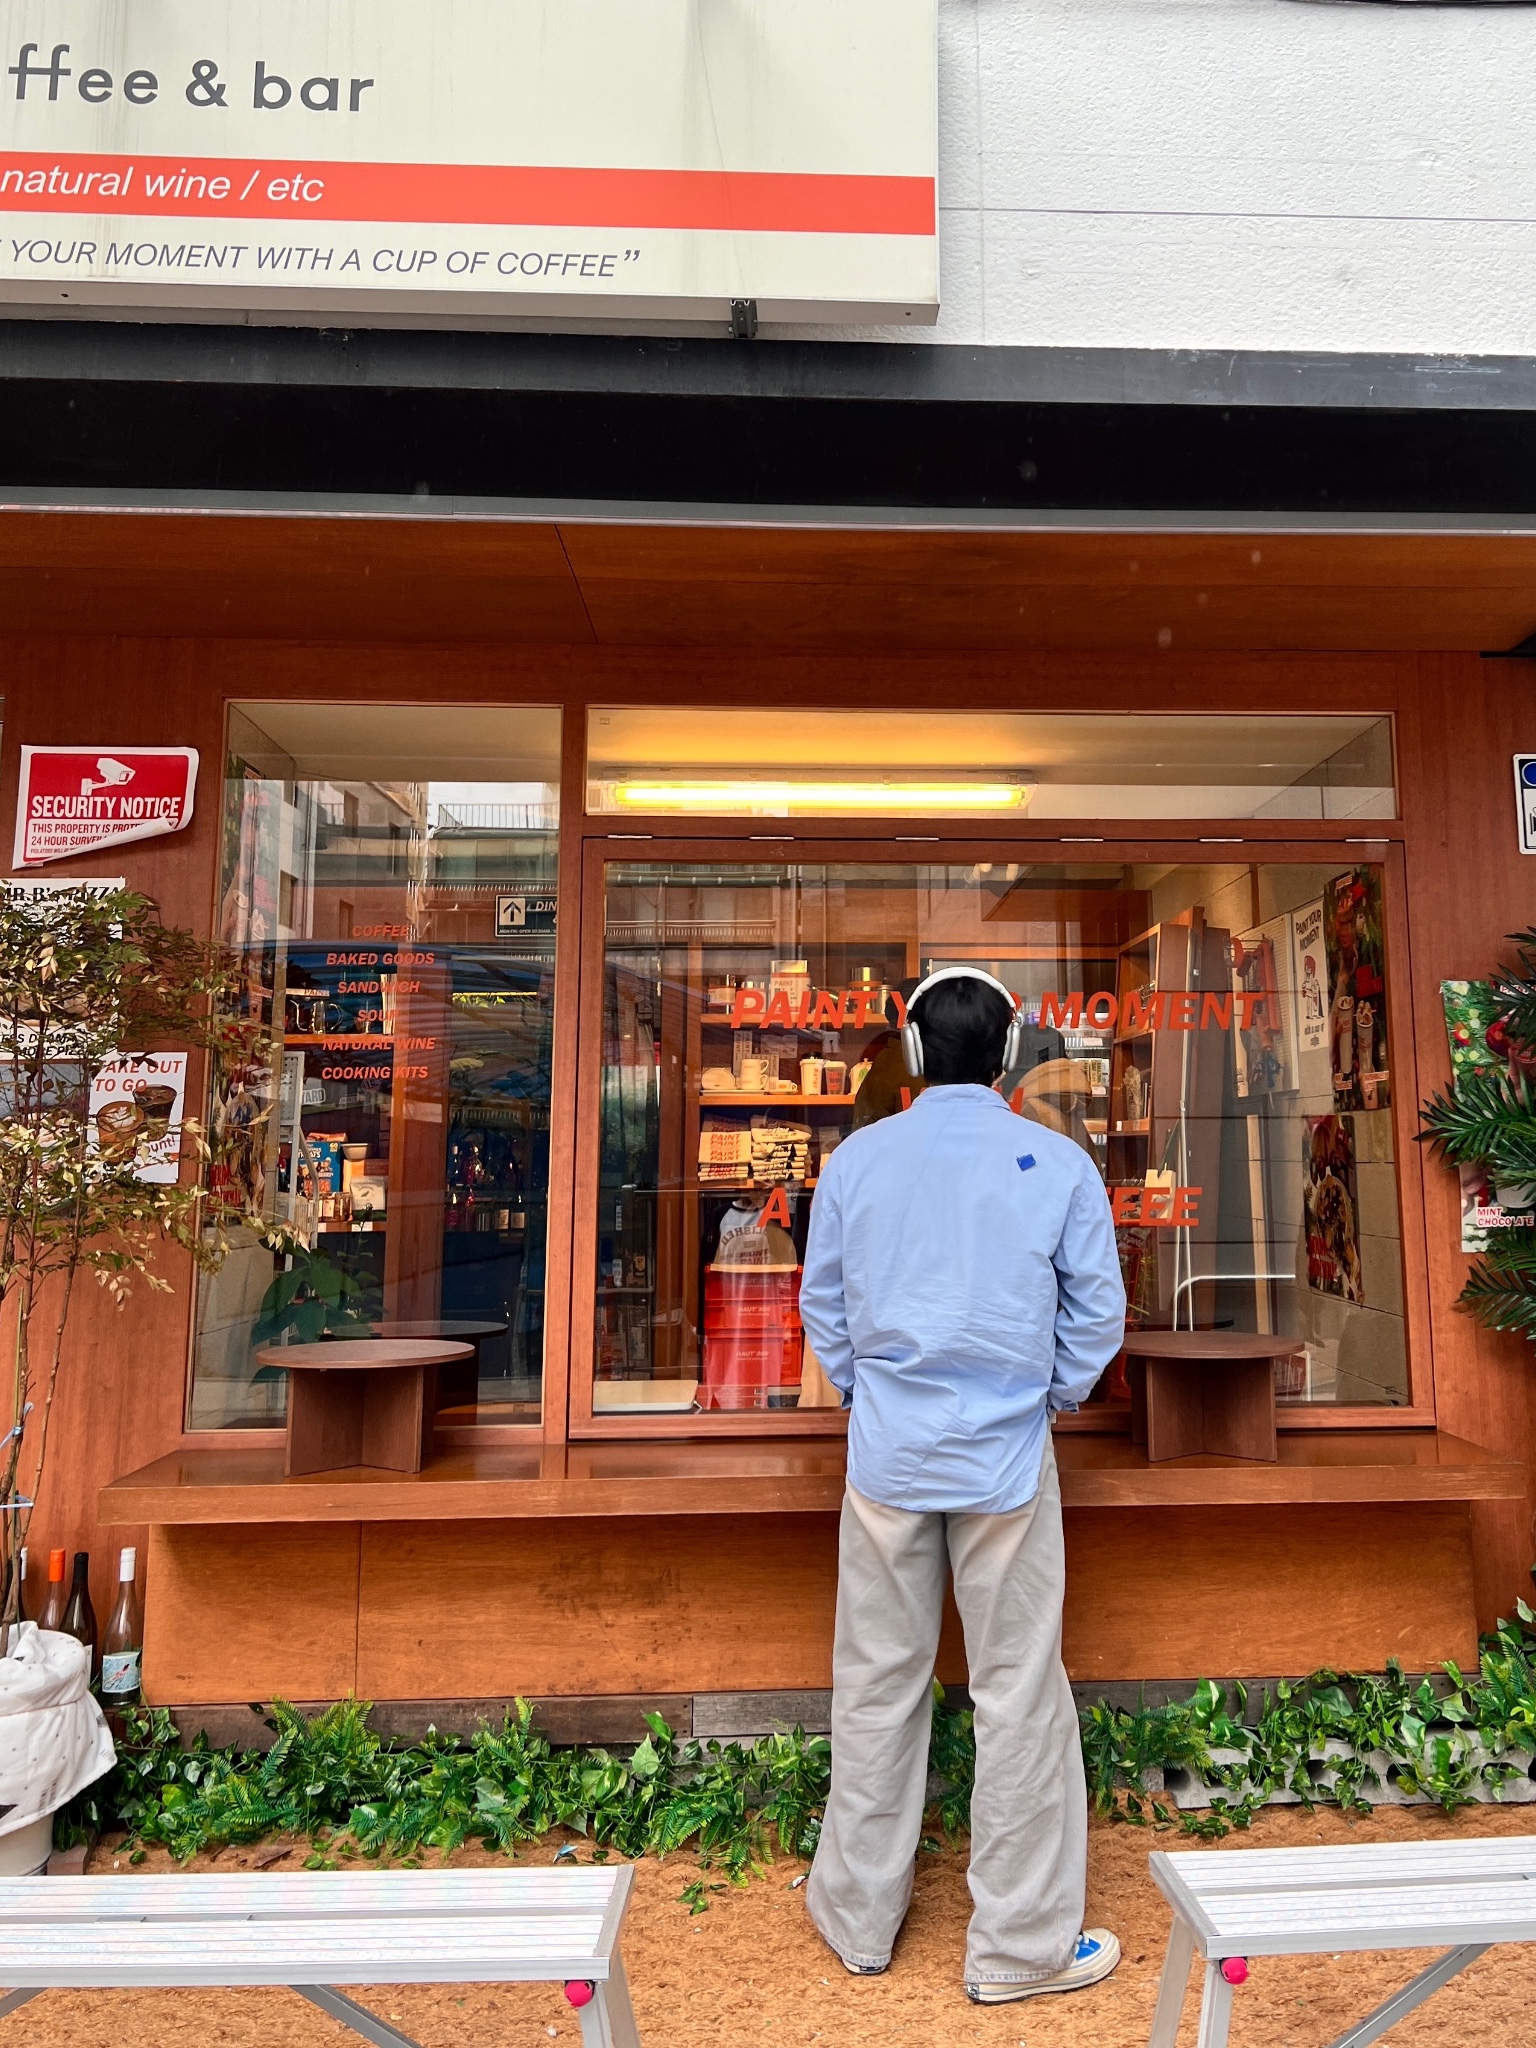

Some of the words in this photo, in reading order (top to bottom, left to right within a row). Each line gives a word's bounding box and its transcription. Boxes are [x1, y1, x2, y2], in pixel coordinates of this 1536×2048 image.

[8, 43, 158, 104] ffee
[185, 59, 229, 107] &
[253, 61, 374, 111] bar
[0, 165, 134, 196] natural
[145, 168, 231, 199] wine
[240, 170, 260, 200] /
[267, 173, 325, 202] etc
[11, 240, 97, 264] YOUR
[105, 242, 249, 269] MOMENT
[257, 246, 334, 271] WITH
[340, 248, 361, 271] A
[372, 249, 437, 273] CUP
[446, 251, 490, 274] OF
[32, 795, 116, 818] SECURITY
[120, 796, 181, 818] NOTICE
[32, 823, 52, 833] THIS
[55, 823, 101, 833] PROPERTY
[102, 823, 111, 833] IS
[31, 836, 41, 845] 24
[44, 836, 68, 845] HOUR
[352, 925, 409, 937] COFFEE
[326, 953, 379, 965] BAKED
[382, 953, 435, 965] GOODS
[337, 981, 421, 993] SANDWICH
[358, 1009, 399, 1022] SOUP
[731, 991, 878, 1029] PAINT
[1039, 991, 1264, 1030] MOMENT
[322, 1038, 392, 1050] NATURAL
[397, 1037, 437, 1049] WINE
[148, 1060, 183, 1073] OUT
[322, 1067, 391, 1079] COOKING
[395, 1066, 429, 1079] KITS
[95, 1079, 116, 1091] TO
[122, 1079, 147, 1092] GO
[757, 1187, 791, 1228] A
[1478, 1208, 1502, 1216] MINT
[1478, 1217, 1533, 1226] CHOCOLATE
